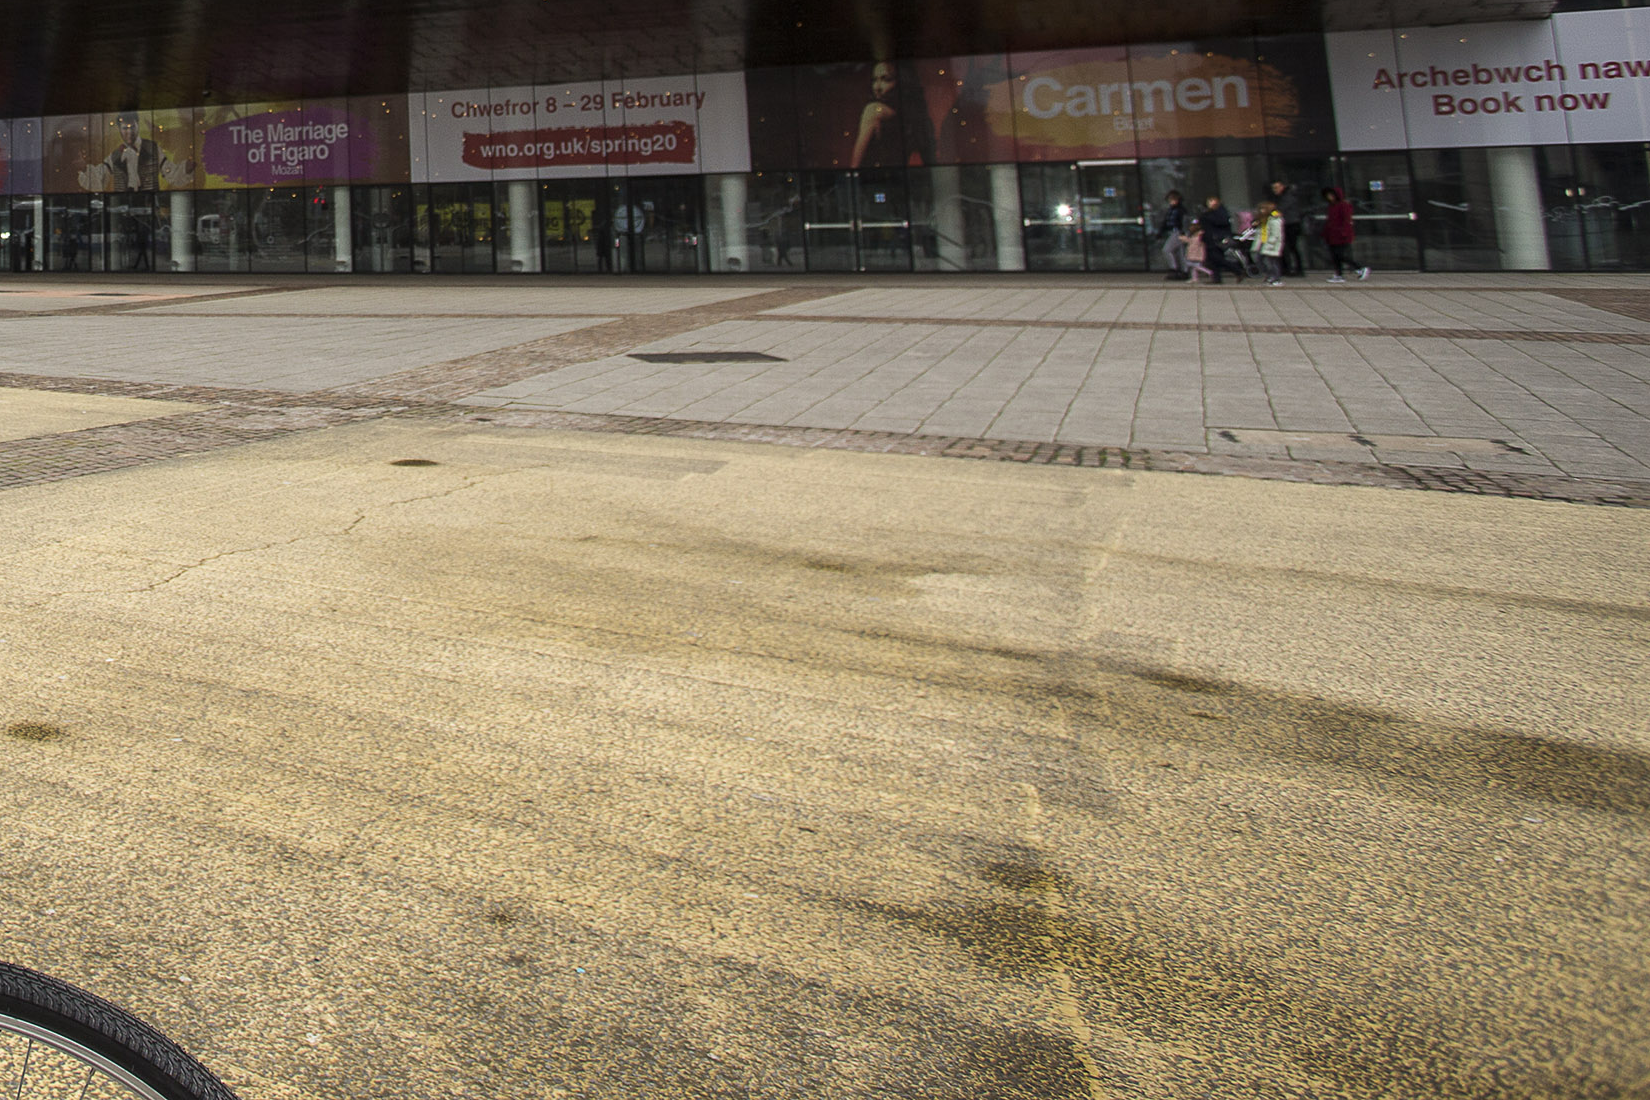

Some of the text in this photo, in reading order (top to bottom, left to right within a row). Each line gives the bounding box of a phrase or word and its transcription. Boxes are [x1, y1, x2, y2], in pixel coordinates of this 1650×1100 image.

[1372, 58, 1650, 90] Archebwch naw
[451, 100, 539, 119] Chwefror
[545, 97, 558, 113] 8
[580, 95, 604, 112] 29
[611, 91, 706, 110] February
[1022, 75, 1248, 119] Carmen
[1432, 91, 1611, 116] Book now
[230, 120, 348, 145] The Marriage
[248, 143, 329, 166] of Figaro
[480, 133, 677, 159] wno.org.uk/spring20
